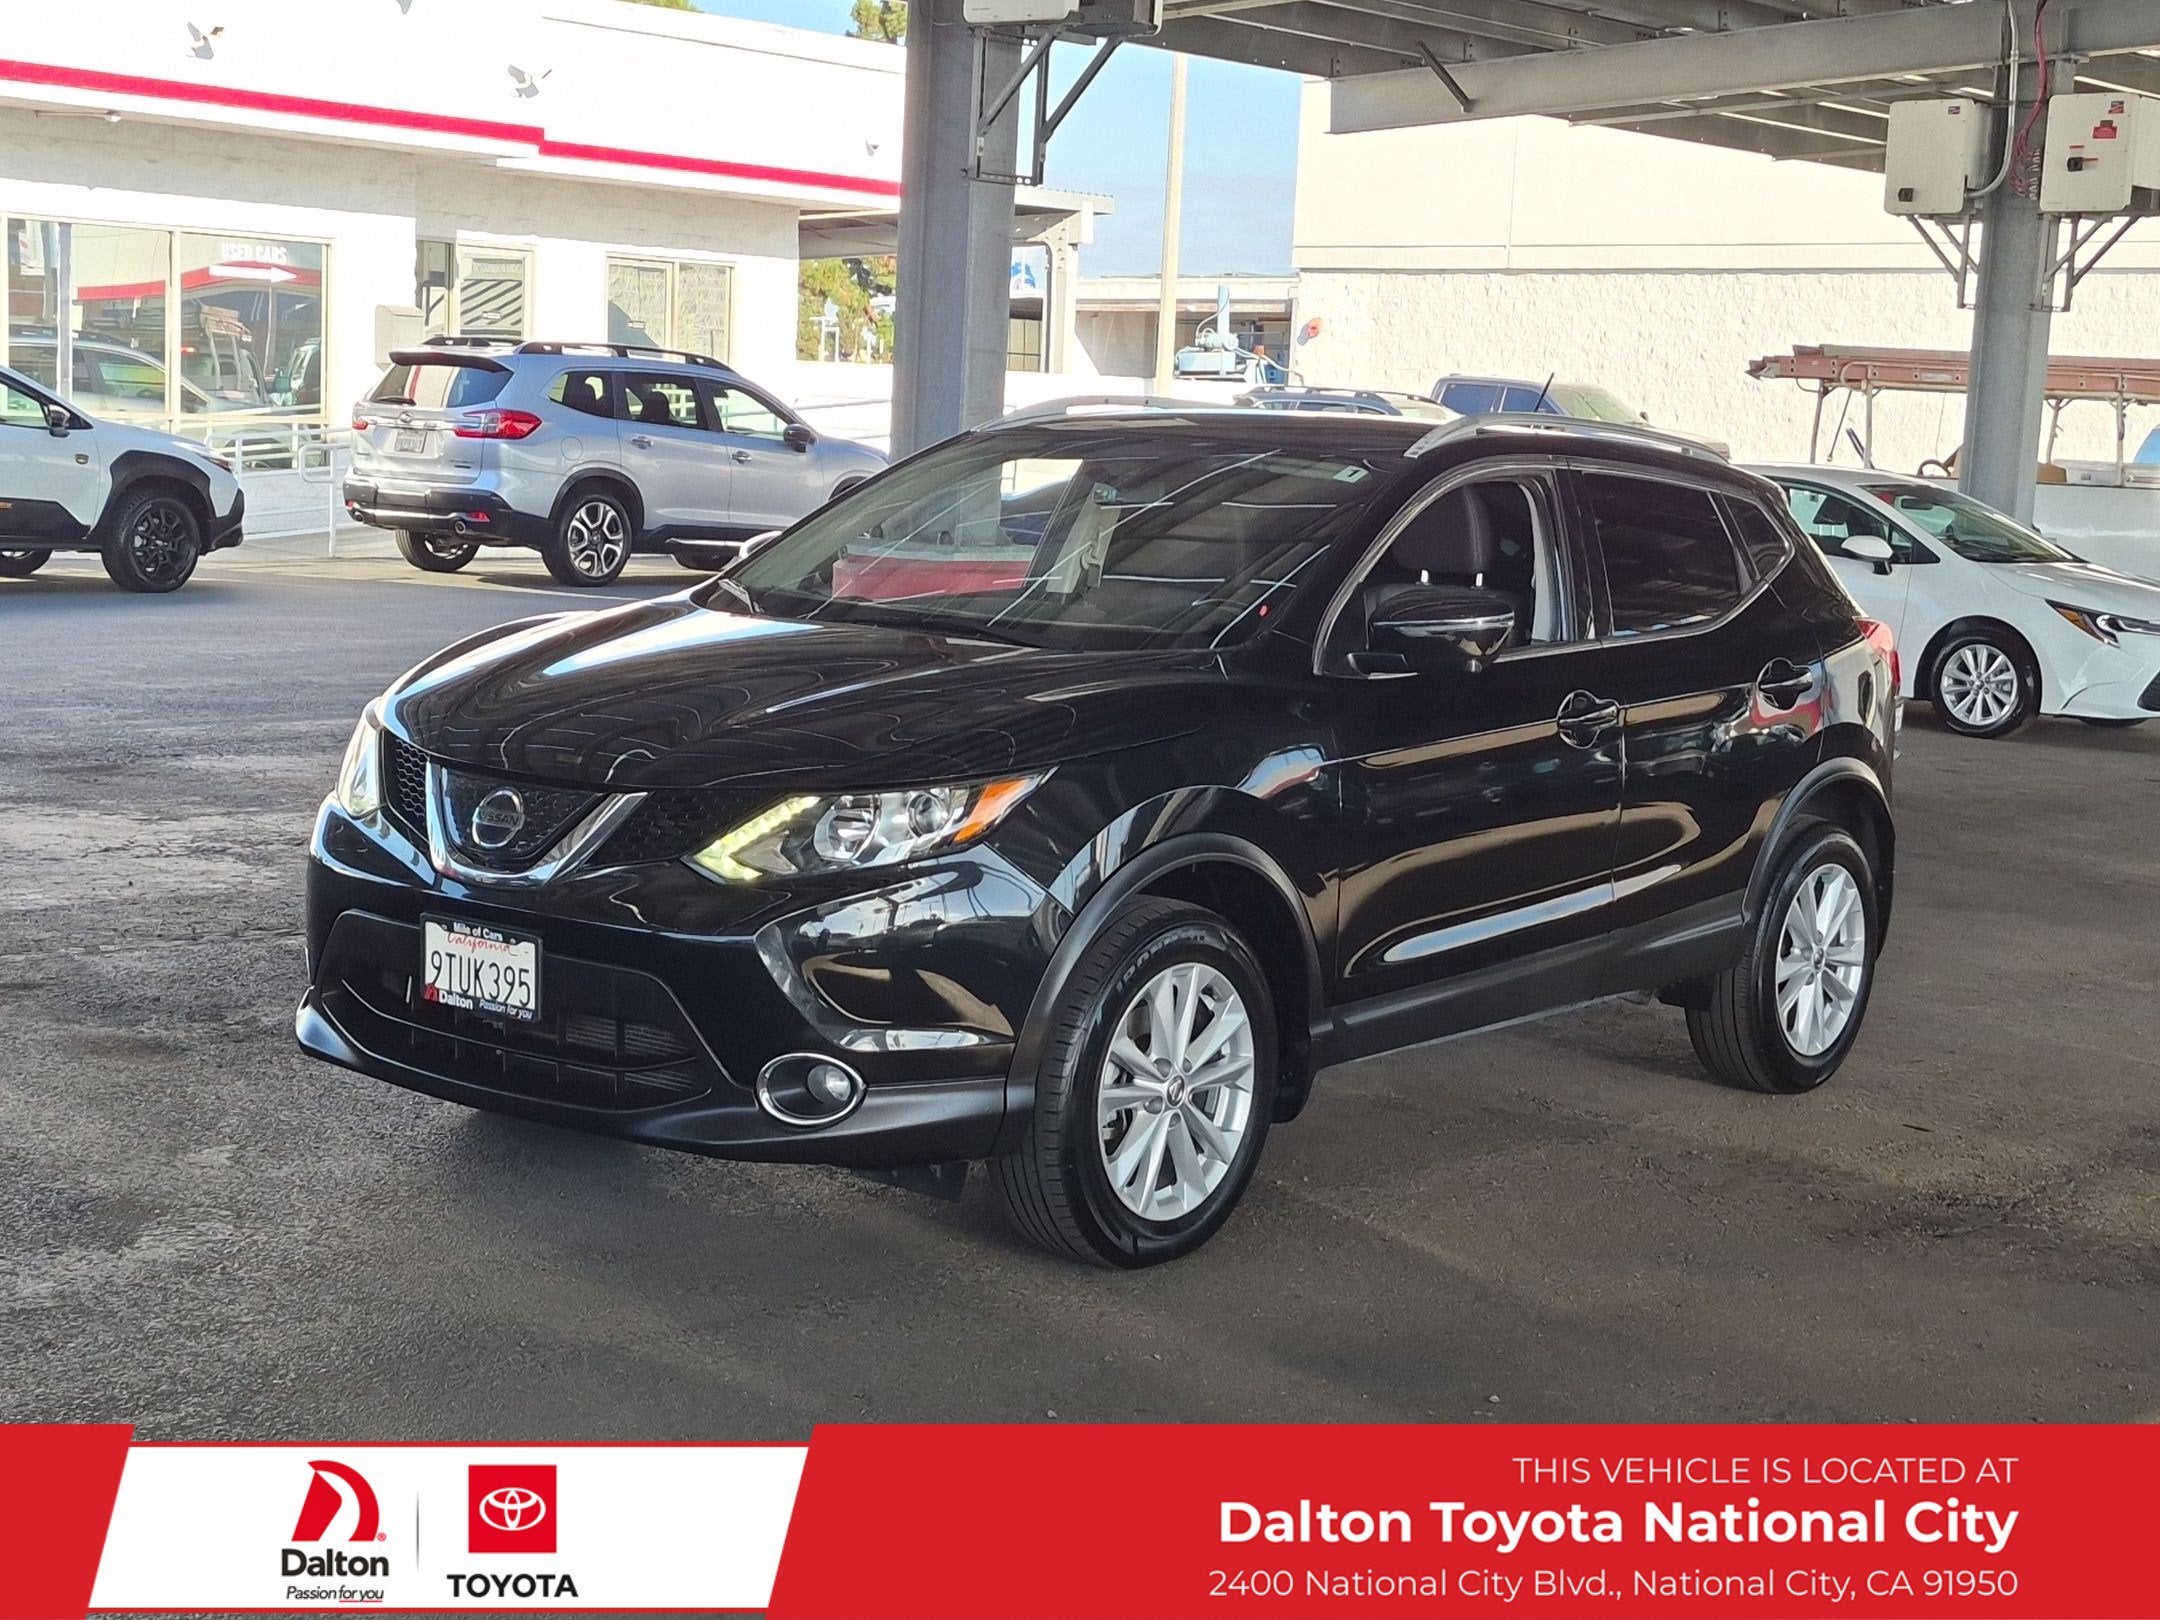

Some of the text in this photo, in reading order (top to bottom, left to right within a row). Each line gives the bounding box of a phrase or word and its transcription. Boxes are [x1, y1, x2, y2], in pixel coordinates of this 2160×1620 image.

[221, 242, 287, 264] USED CARS
[453, 922, 503, 941] Mile of Cars
[447, 932, 518, 956] California
[431, 950, 531, 1007] 9TUK395
[438, 990, 473, 1010] Dalton
[479, 1000, 533, 1020] Passion for you
